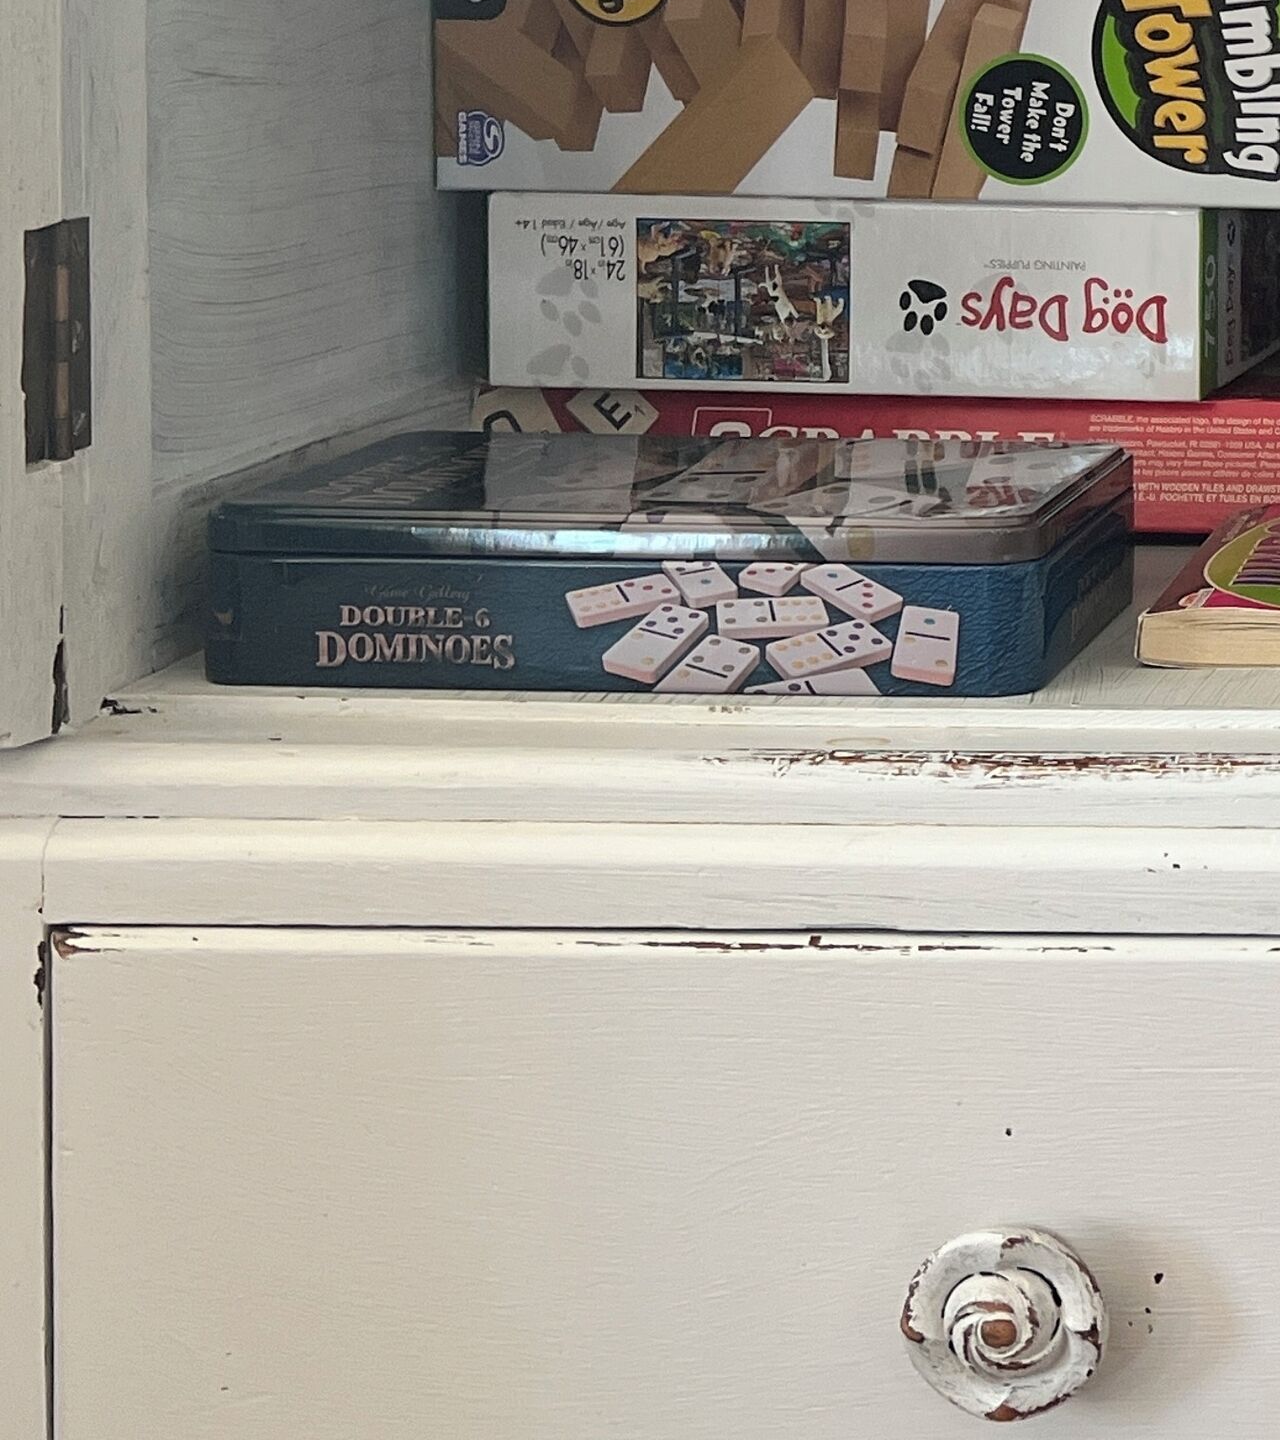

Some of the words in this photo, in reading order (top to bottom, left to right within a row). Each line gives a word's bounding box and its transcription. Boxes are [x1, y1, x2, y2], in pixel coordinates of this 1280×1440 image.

[968, 91, 996, 134] Fall!
[994, 85, 1024, 147] Tower
[1022, 81, 1052, 128] Make
[1019, 130, 1044, 164] the
[1047, 100, 1077, 155] Don't
[339, 604, 492, 629] DOUBLE-6
[314, 630, 515, 670] DOMINOES
